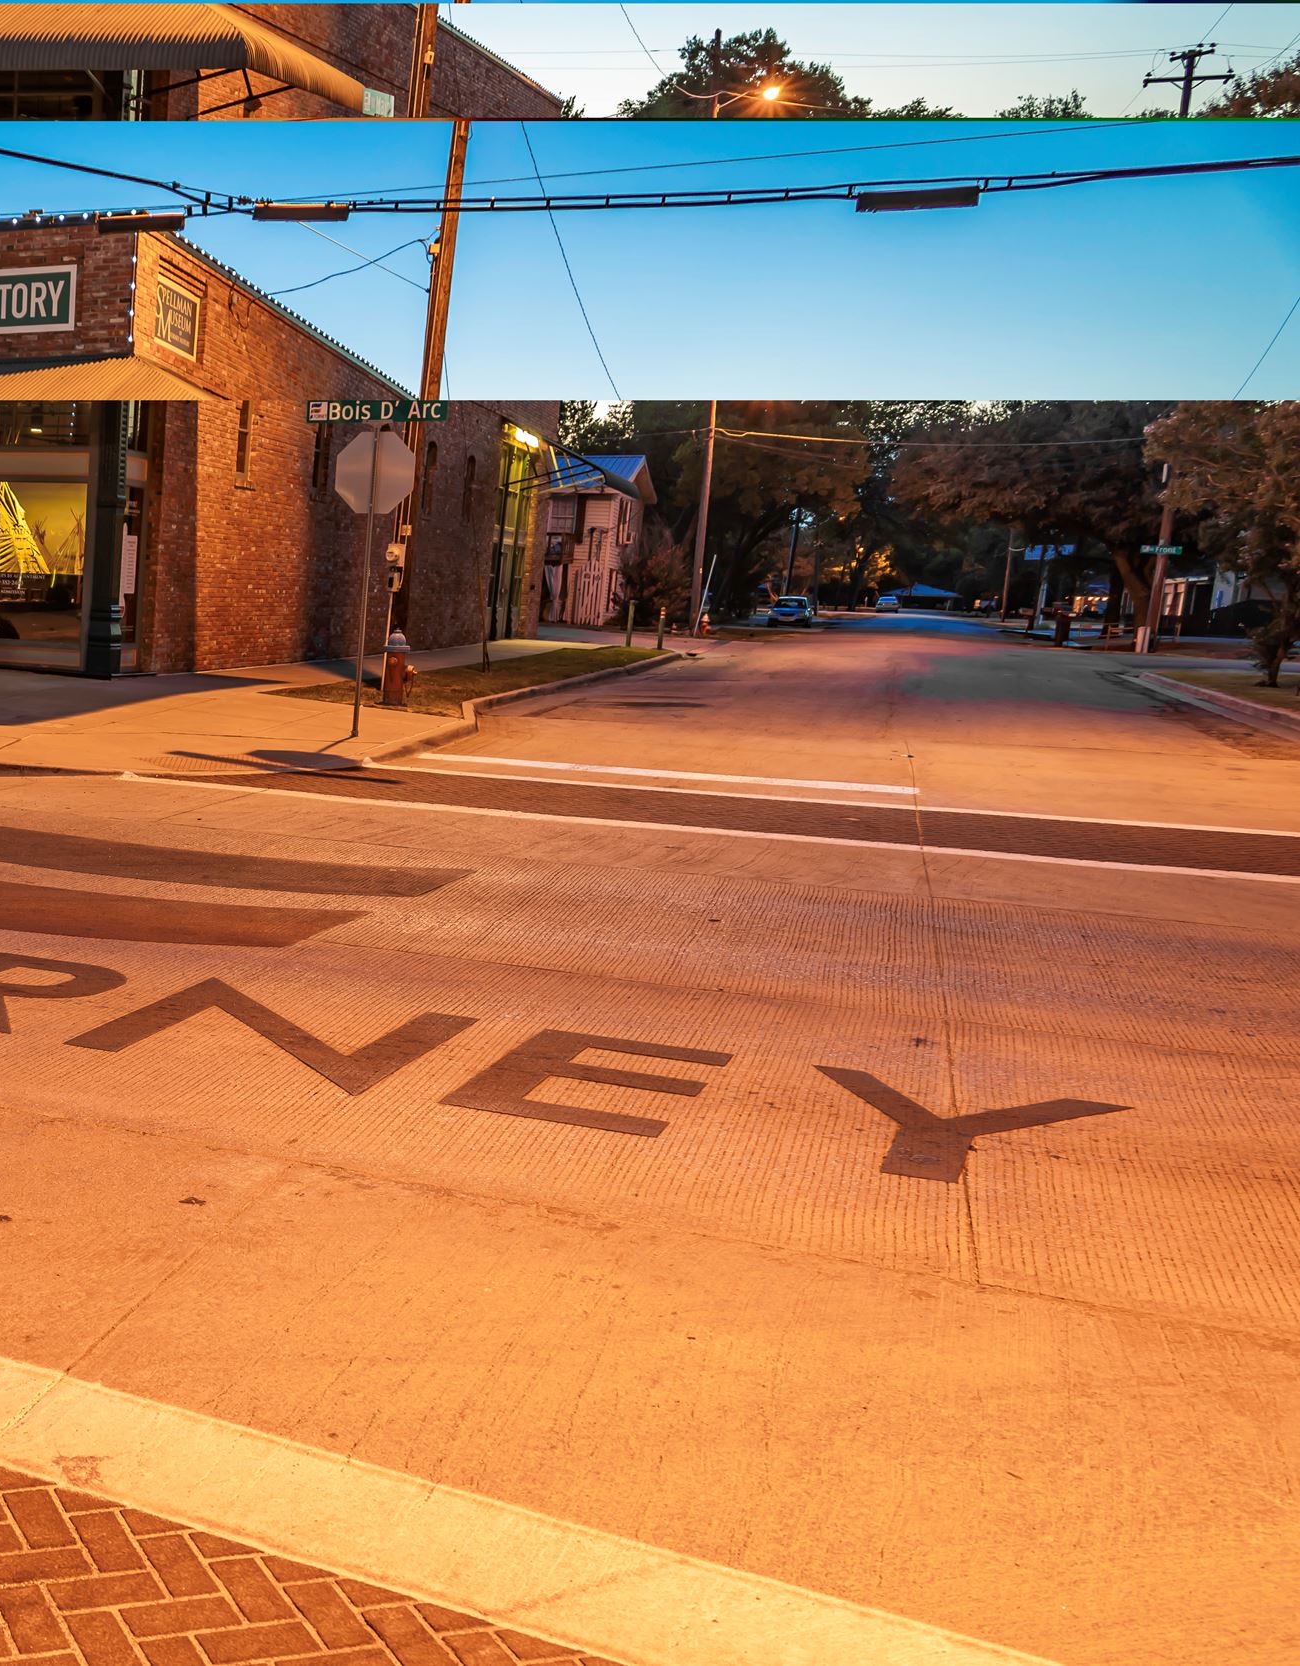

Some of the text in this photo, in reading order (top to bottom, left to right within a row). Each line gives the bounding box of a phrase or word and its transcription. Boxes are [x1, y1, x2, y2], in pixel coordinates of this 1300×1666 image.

[156, 284, 193, 318] SPELLMAN
[157, 309, 191, 342] MUSEUM
[328, 401, 371, 420] Bois
[407, 400, 442, 419] Arc
